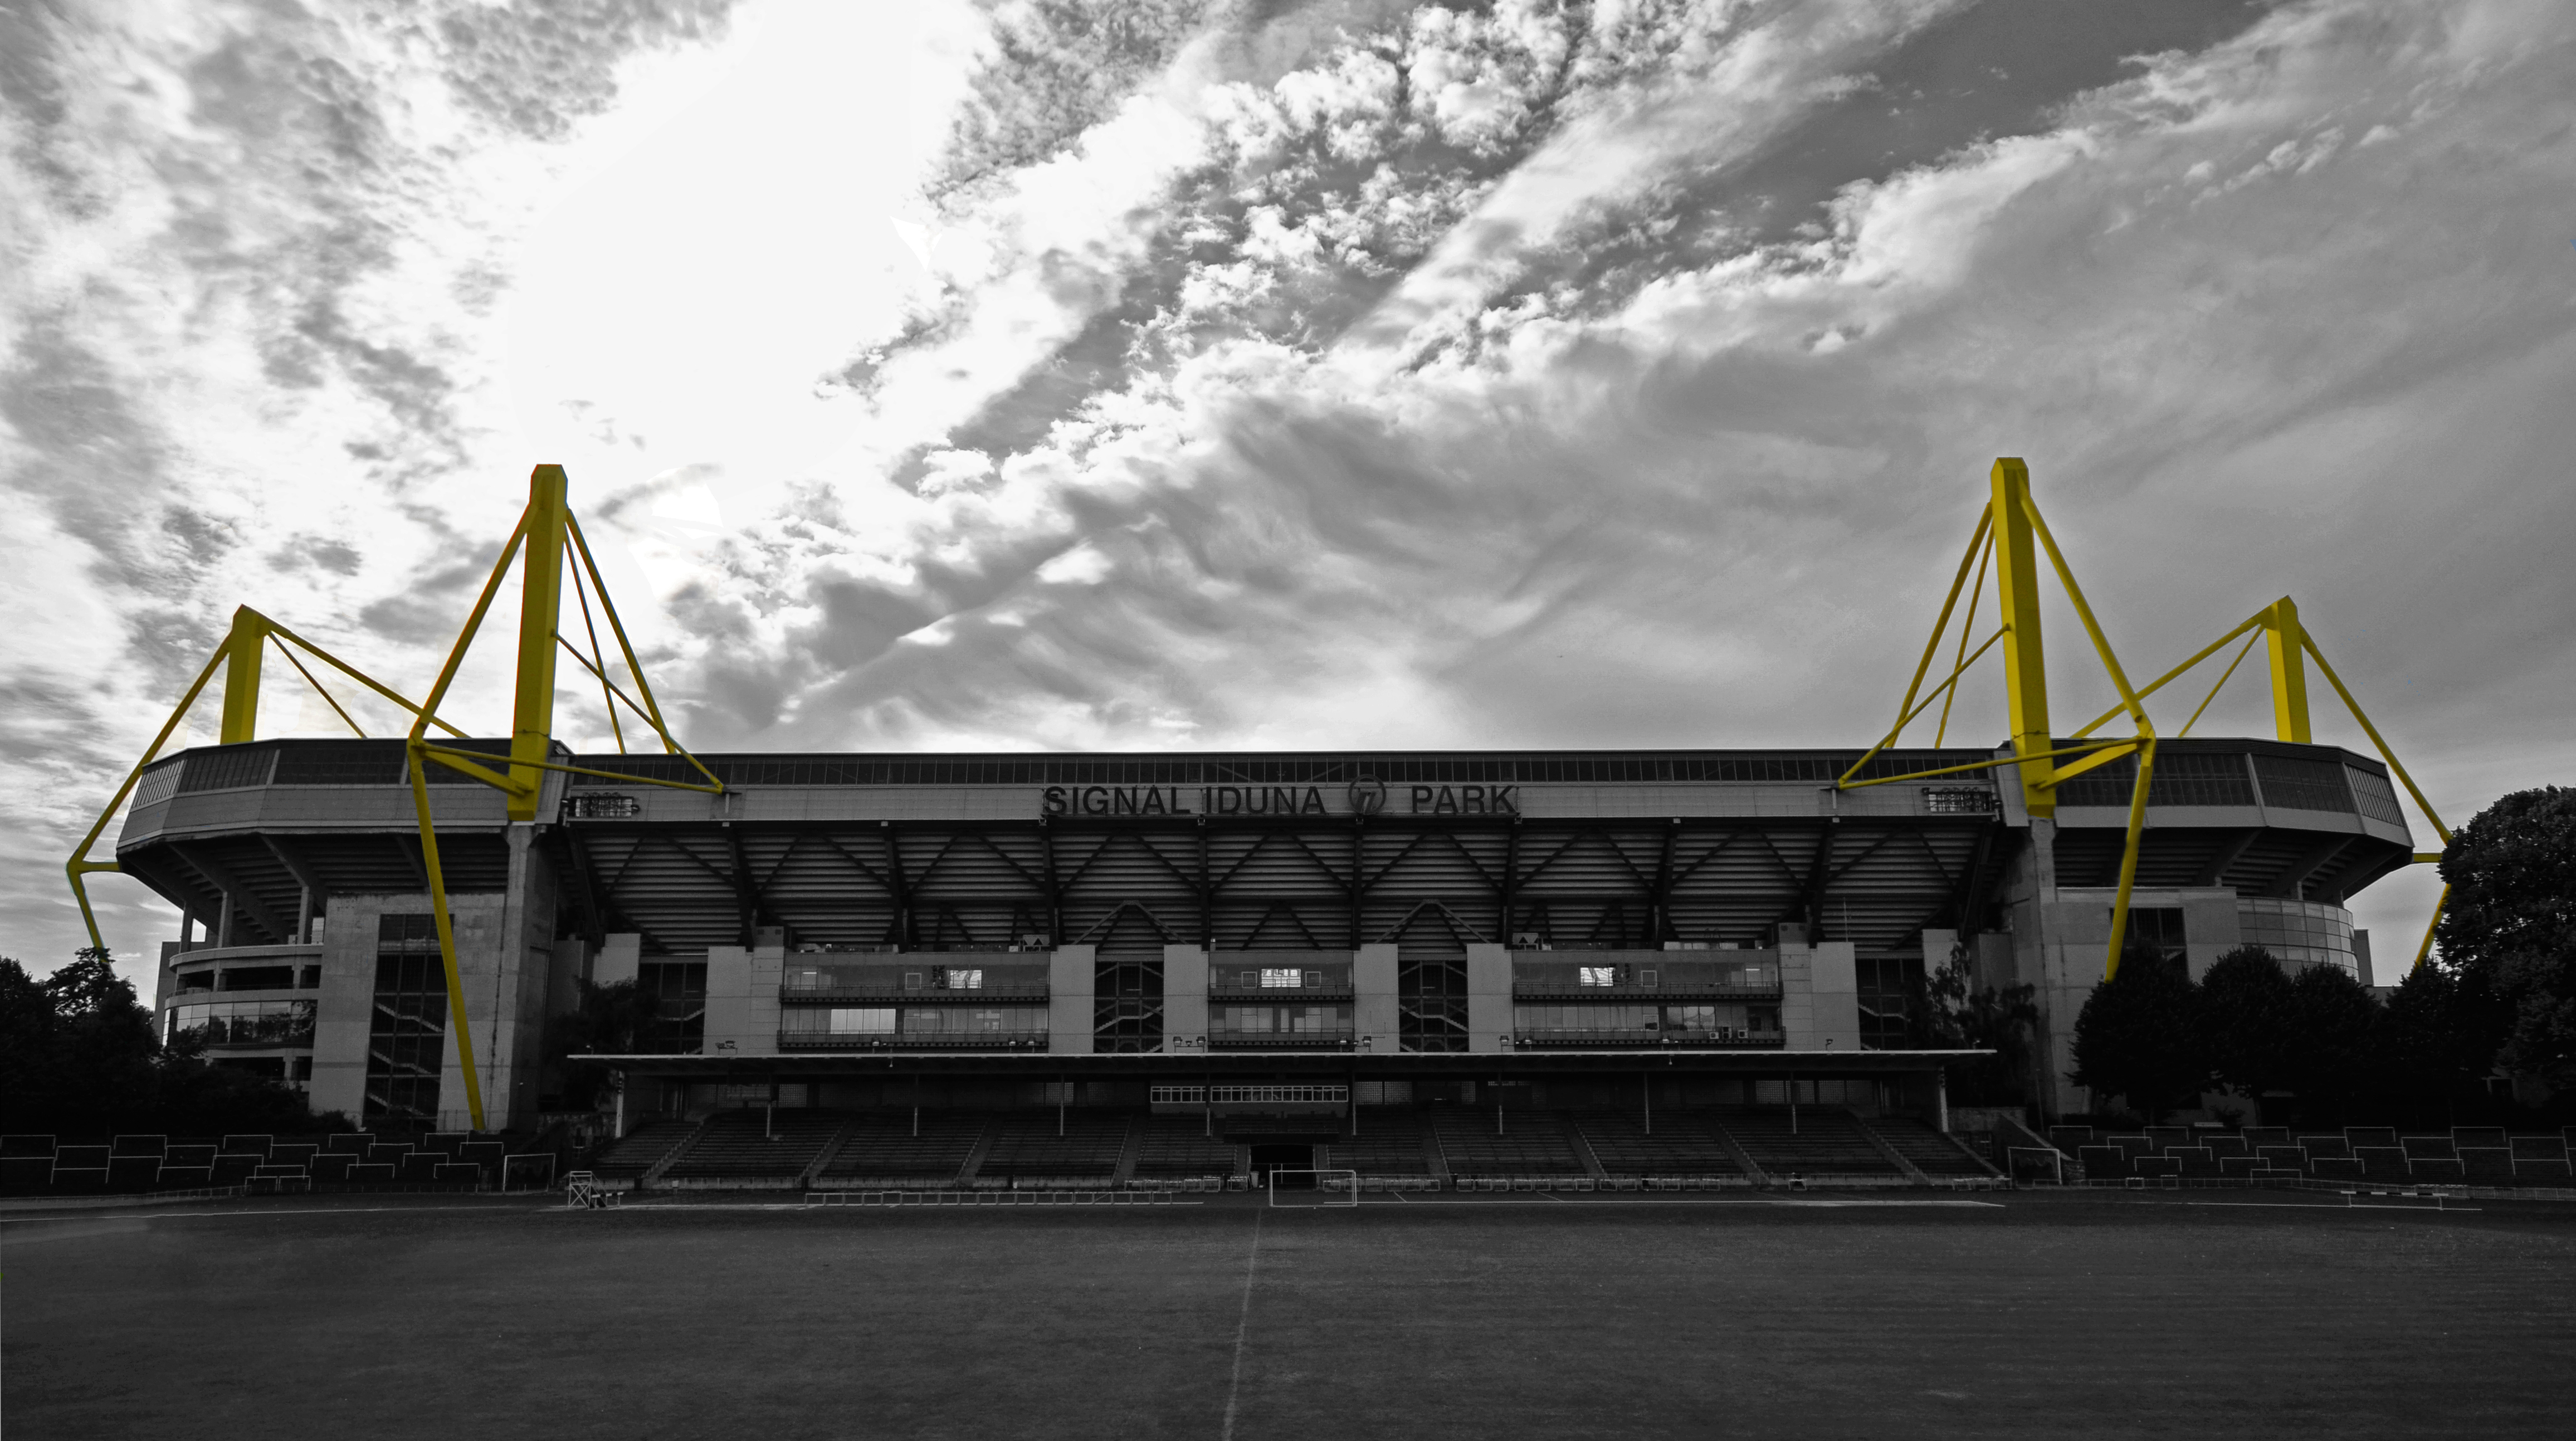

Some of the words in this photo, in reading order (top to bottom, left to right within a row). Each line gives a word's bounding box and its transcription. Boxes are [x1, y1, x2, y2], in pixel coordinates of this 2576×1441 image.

[1045, 786, 1191, 814] SIGNAL
[1206, 786, 1326, 814] IDUNA
[1412, 785, 1518, 814] PARK
